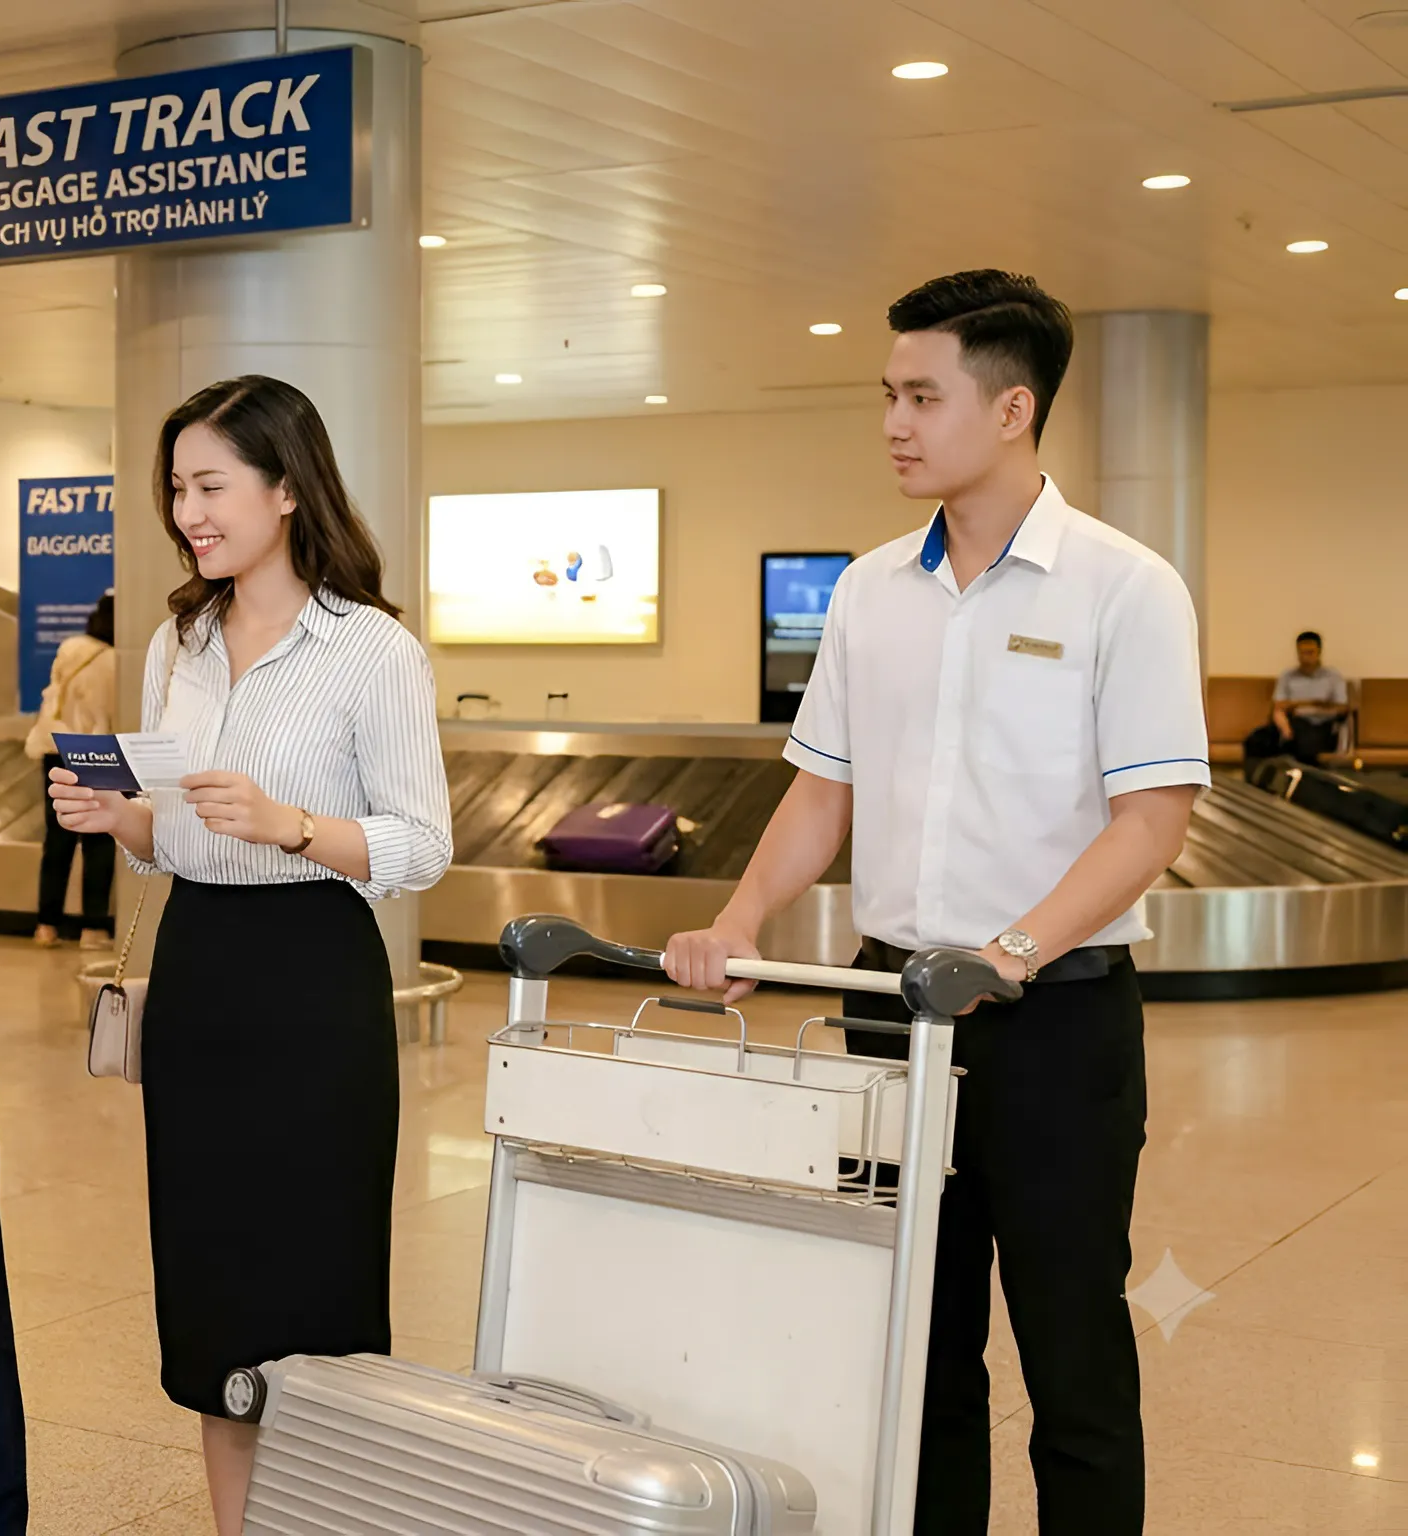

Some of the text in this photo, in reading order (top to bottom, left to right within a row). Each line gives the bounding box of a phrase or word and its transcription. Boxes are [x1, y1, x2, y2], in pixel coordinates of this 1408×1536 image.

[109, 73, 321, 155] TRACK
[104, 145, 307, 199] ASSISTANCE
[34, 217, 67, 246] VỤ
[165, 197, 235, 229] HÀNH
[26, 485, 92, 515] FAST
[26, 533, 113, 556] BAGGAGE
